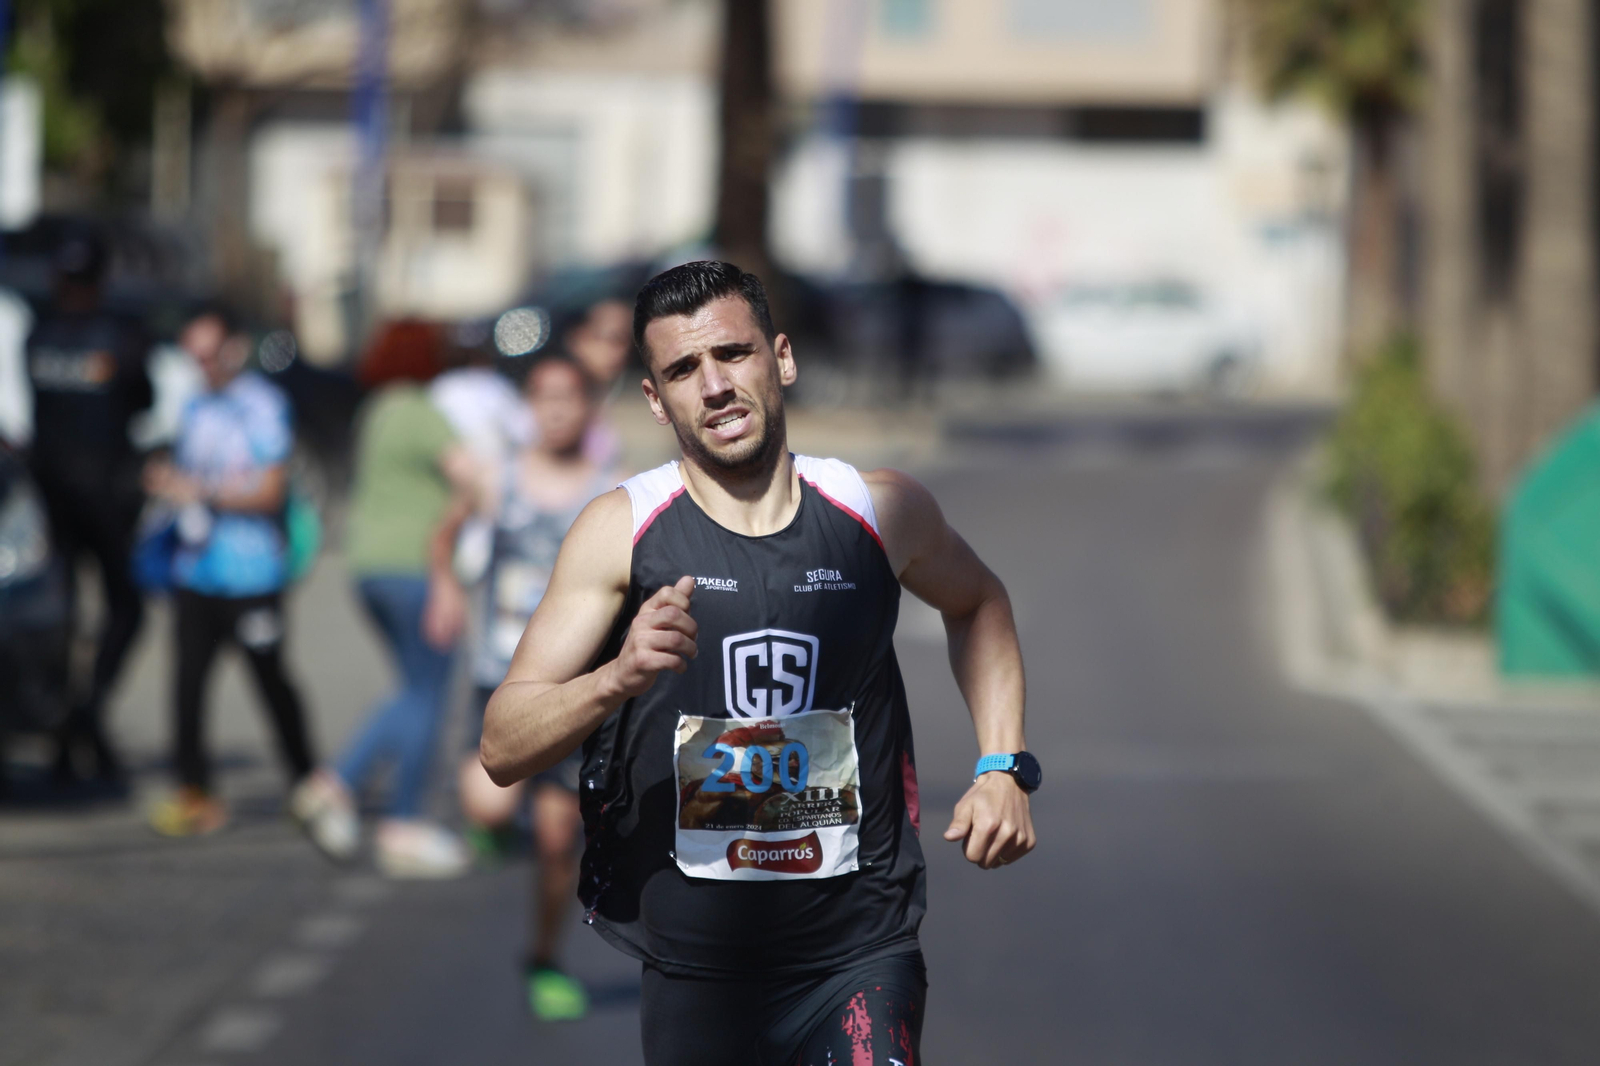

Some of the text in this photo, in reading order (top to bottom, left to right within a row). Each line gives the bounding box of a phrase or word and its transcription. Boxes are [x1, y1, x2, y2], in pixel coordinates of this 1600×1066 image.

[806, 568, 842, 583] SEGURA
[696, 577, 738, 588] TAKELOT
[813, 582, 823, 591] DE
[823, 582, 857, 590] ATLETISMO
[701, 742, 809, 793] 200
[780, 787, 842, 805] XIII
[780, 800, 843, 812] CARRERA
[780, 806, 841, 818] POPULAR
[792, 811, 842, 822] ESPARTANOS
[778, 822, 797, 830] DEL
